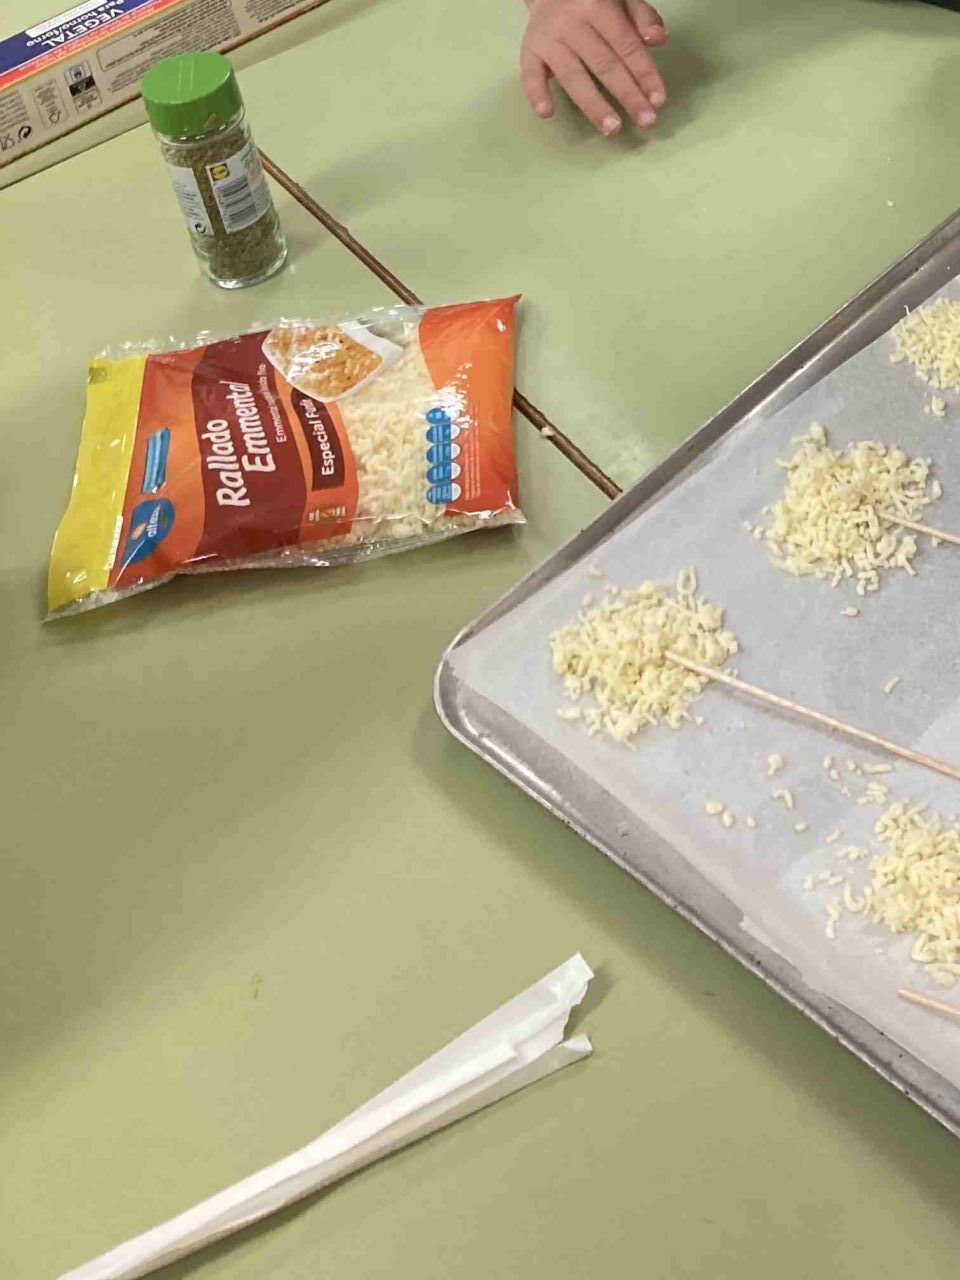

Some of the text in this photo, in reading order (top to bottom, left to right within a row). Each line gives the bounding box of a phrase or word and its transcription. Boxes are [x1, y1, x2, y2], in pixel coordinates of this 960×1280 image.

[41, 8, 125, 48] VEGETAL
[200, 418, 251, 507] Rallado
[219, 380, 277, 473] Emmental
[308, 419, 336, 476] Especial
